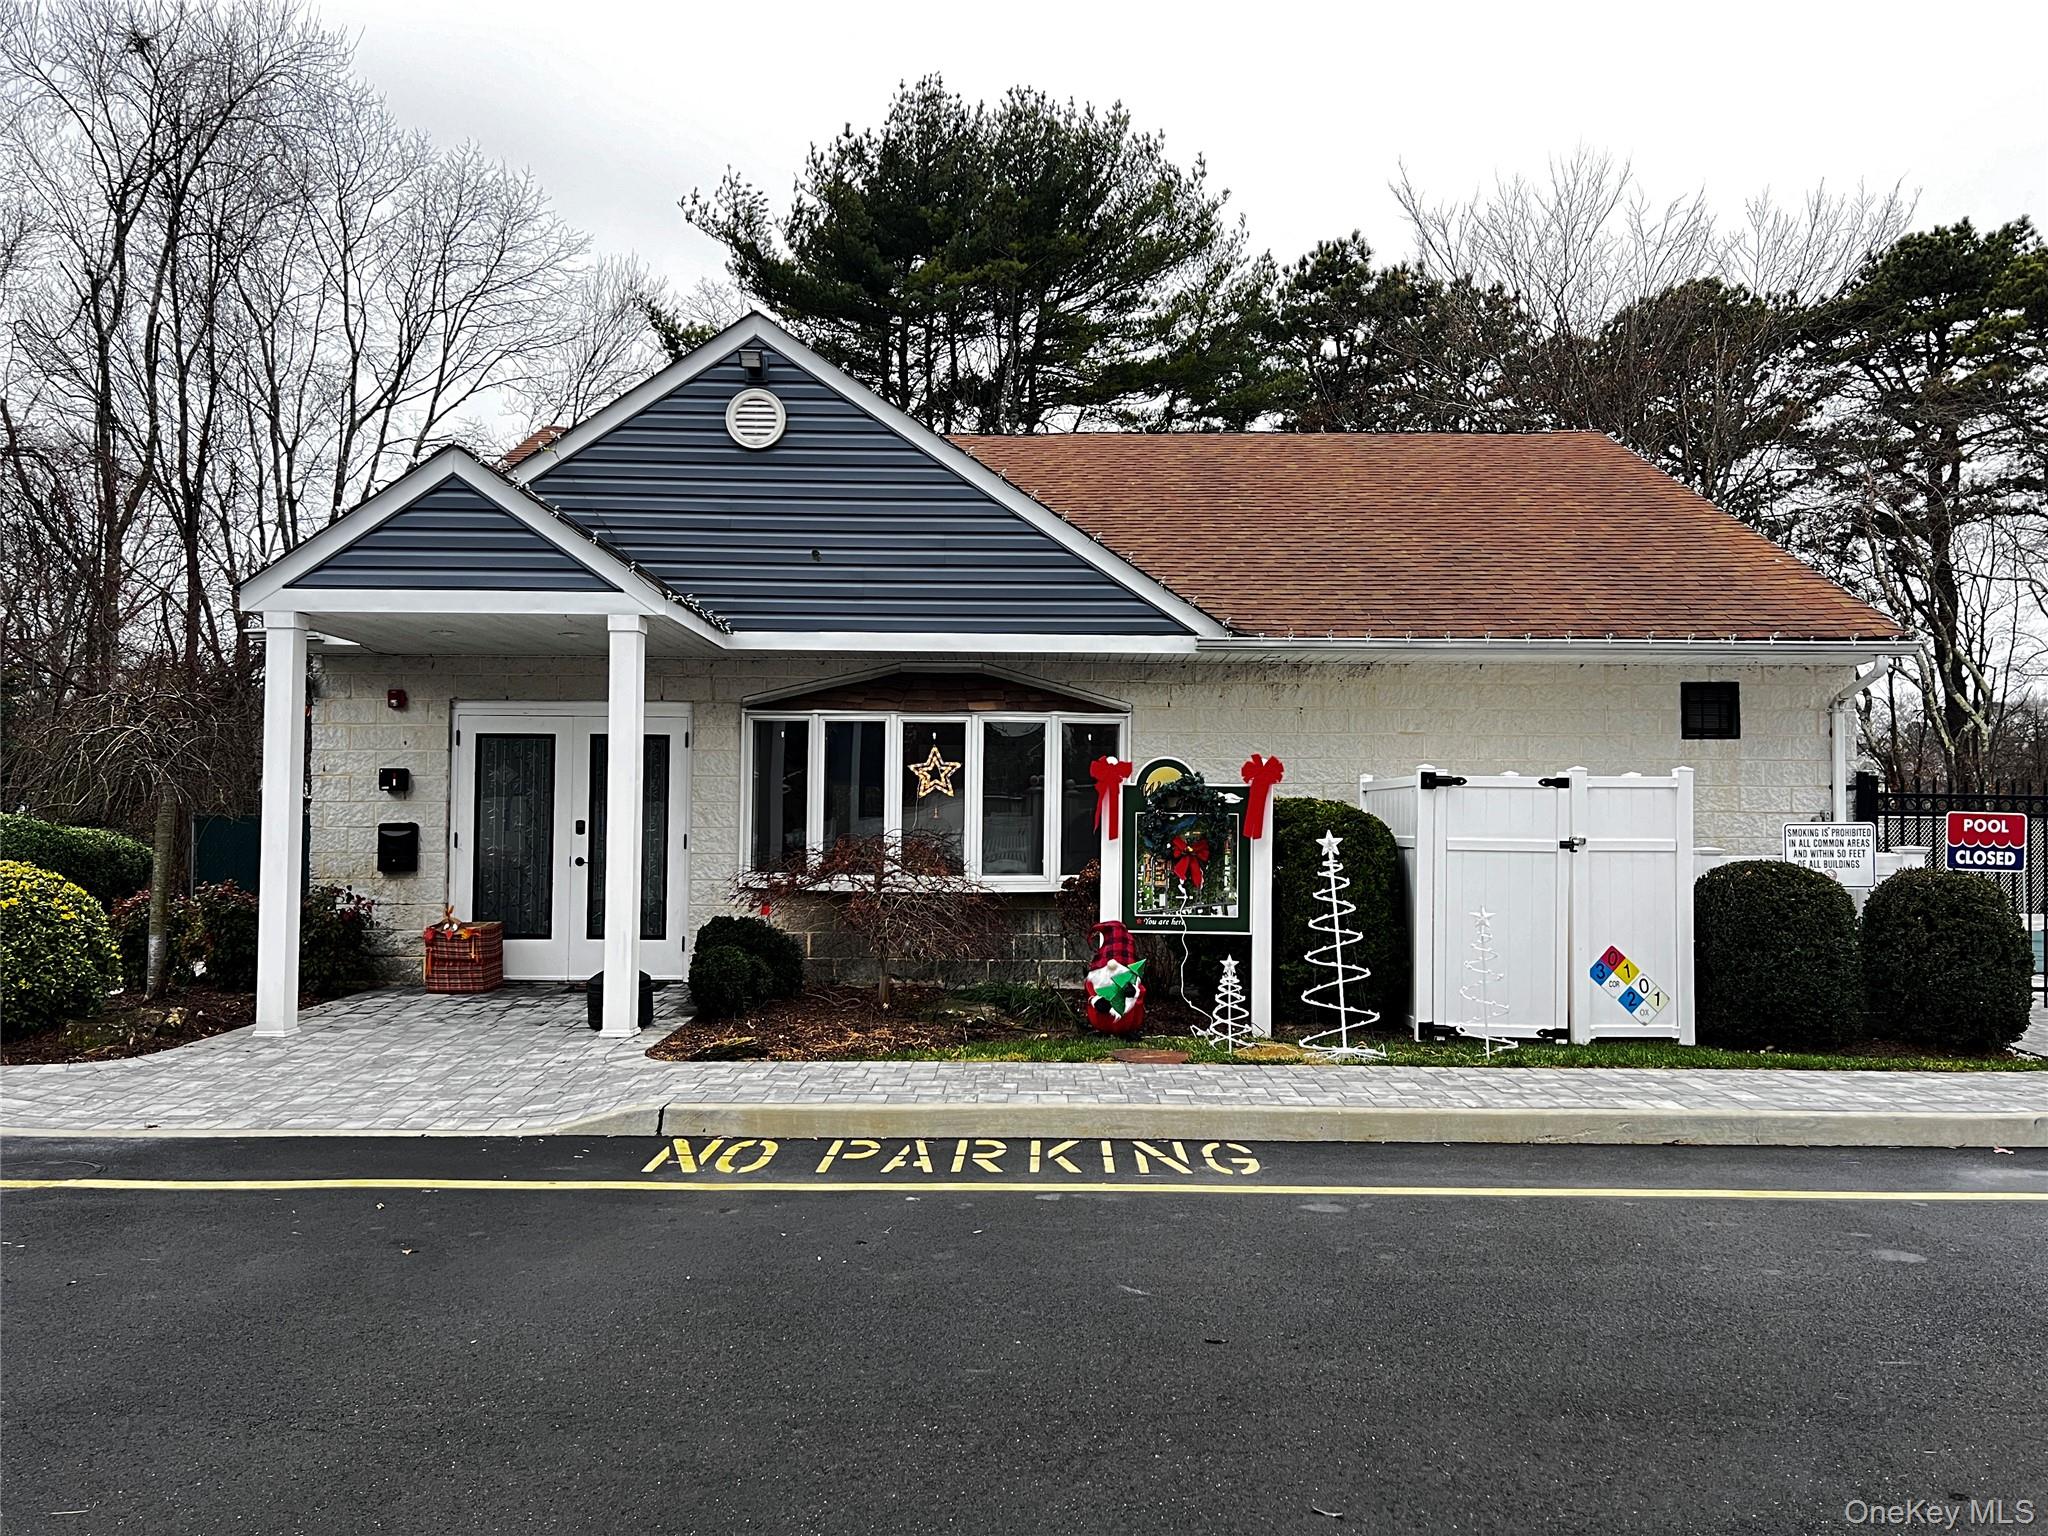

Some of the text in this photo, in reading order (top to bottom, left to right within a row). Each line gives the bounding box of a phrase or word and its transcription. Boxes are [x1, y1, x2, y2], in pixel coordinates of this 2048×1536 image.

[1787, 828, 1872, 837] SMOKING IS PROHIBITED
[1963, 818, 2009, 833] POOL
[1788, 839, 1870, 848] IN ALL COMMON AREAS
[1793, 849, 1866, 858] AND WITHIN 50 FEET
[1955, 849, 2016, 866] CLOSED
[1808, 859, 1821, 868] ALL
[1823, 859, 1860, 868] BUILDINGS
[1144, 917, 1157, 925] You
[1608, 951, 1618, 966] 0
[1596, 963, 1631, 979] 3 1
[1609, 980, 1620, 988] COR
[1638, 978, 1649, 994] 0
[1627, 991, 1660, 1006] 2 1
[641, 1138, 1261, 1175] NO PARKING
